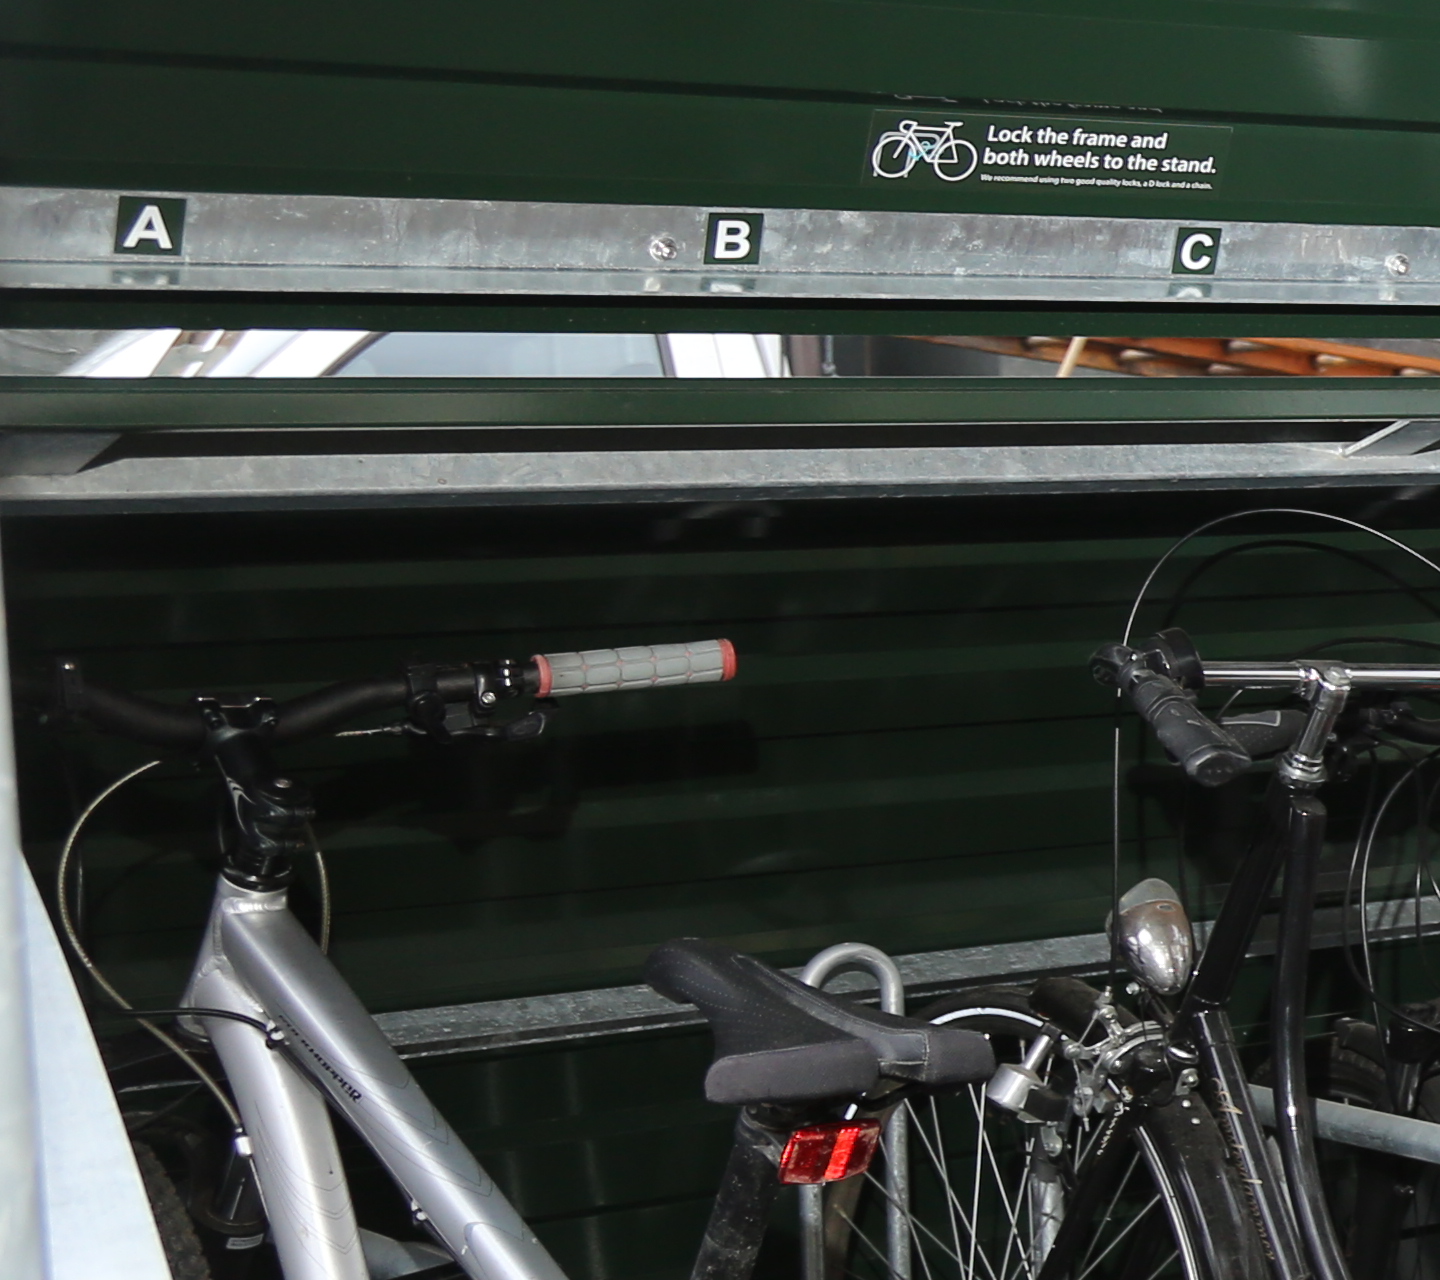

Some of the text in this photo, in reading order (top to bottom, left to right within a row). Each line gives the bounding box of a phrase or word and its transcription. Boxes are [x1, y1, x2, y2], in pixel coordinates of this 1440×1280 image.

[987, 125, 1168, 149] Lock the frame and
[983, 147, 1217, 174] both wheels to the stand.
[980, 173, 993, 182] We
[994, 174, 1038, 183] recommend
[1039, 176, 1060, 186] using
[1060, 176, 1075, 185] two
[1076, 177, 1096, 187] good
[1096, 177, 1121, 188] quality
[1122, 178, 1142, 188] locks,
[1149, 179, 1156, 188] D
[1156, 179, 1170, 188] lock
[1171, 180, 1186, 189] and
[1191, 181, 1214, 190] chain.
[123, 206, 172, 248] A
[715, 221, 750, 258] B
[1181, 234, 1213, 269] C
